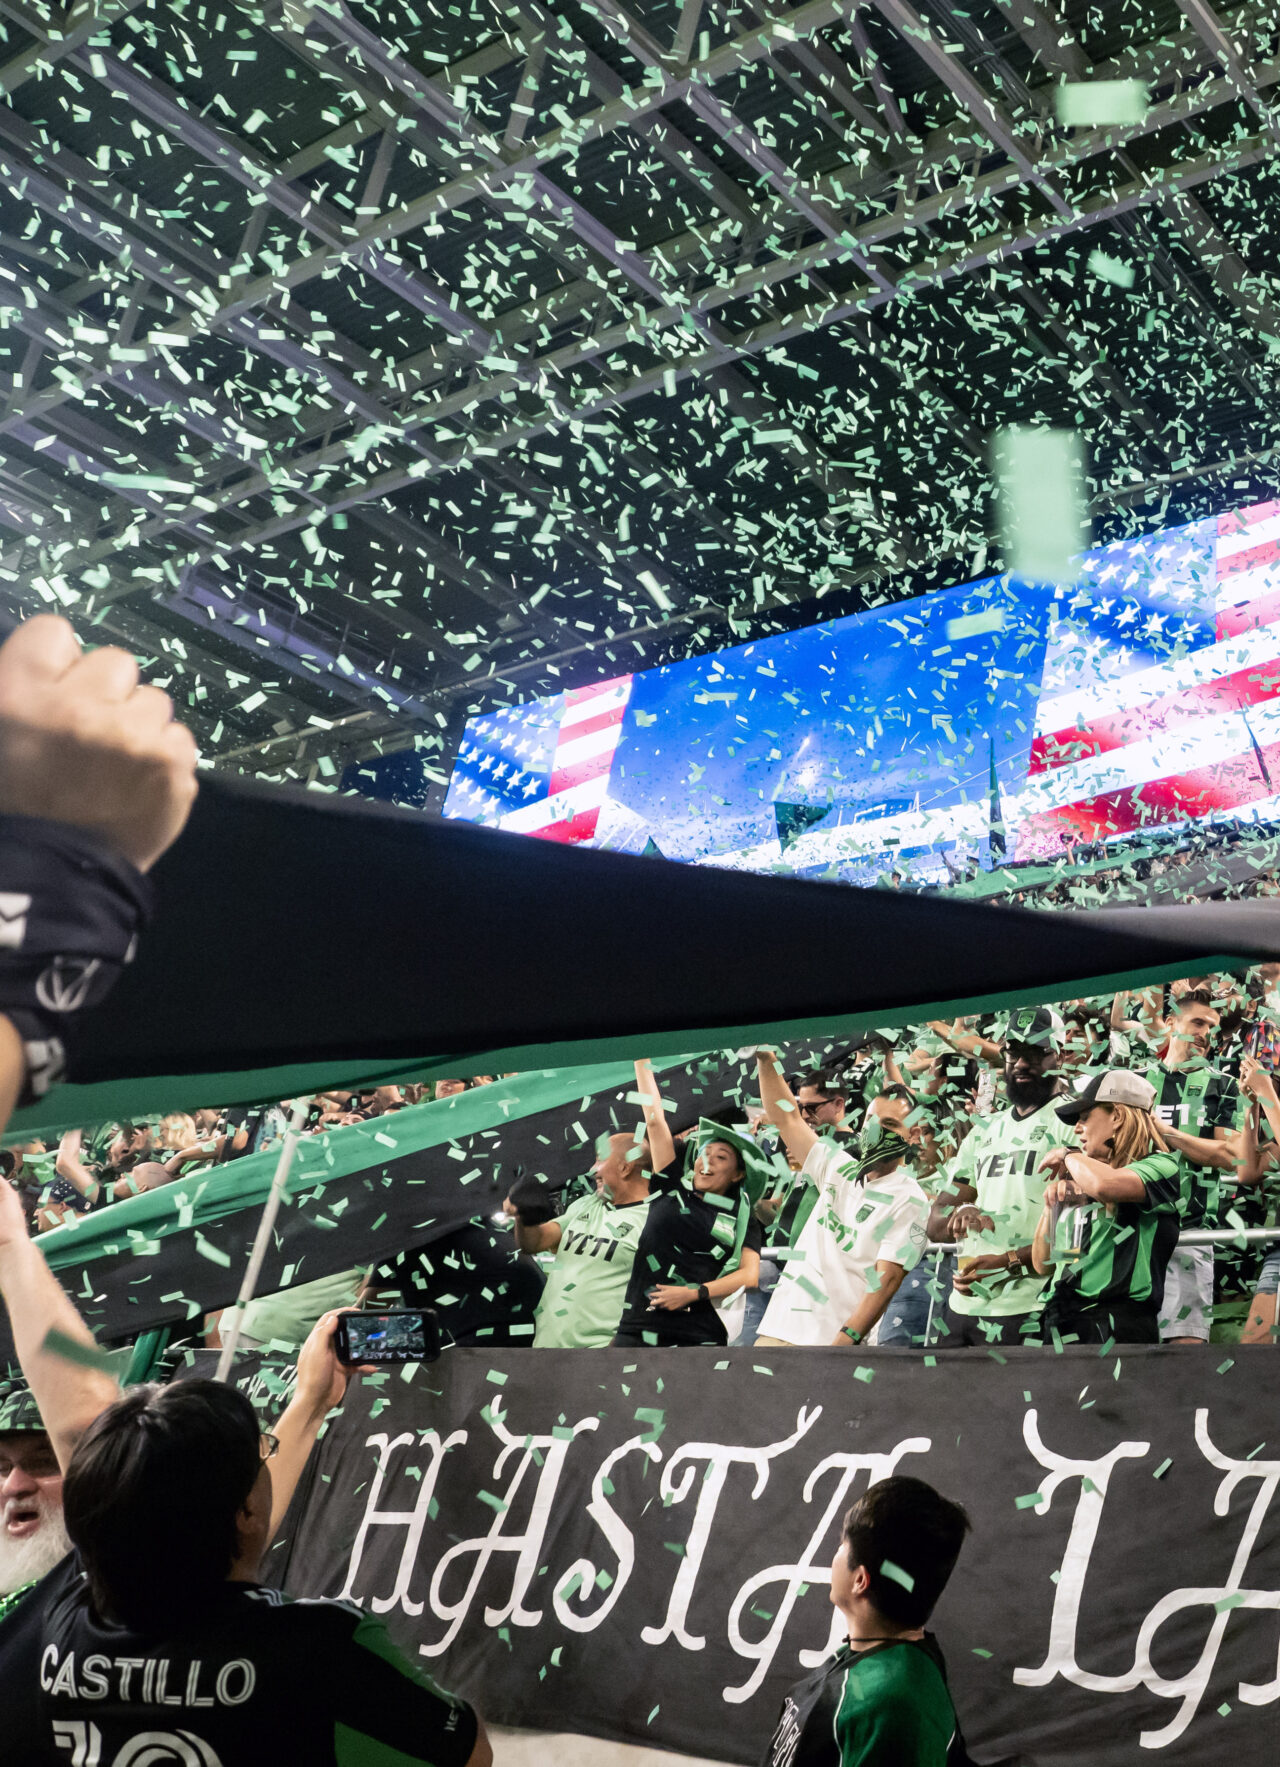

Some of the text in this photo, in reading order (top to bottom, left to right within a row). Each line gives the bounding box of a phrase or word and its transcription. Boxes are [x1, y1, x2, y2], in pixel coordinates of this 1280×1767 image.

[975, 1150, 1038, 1181] YETI
[319, 1394, 932, 1704] HASTA
[40, 1643, 256, 1707] CASTILLO
